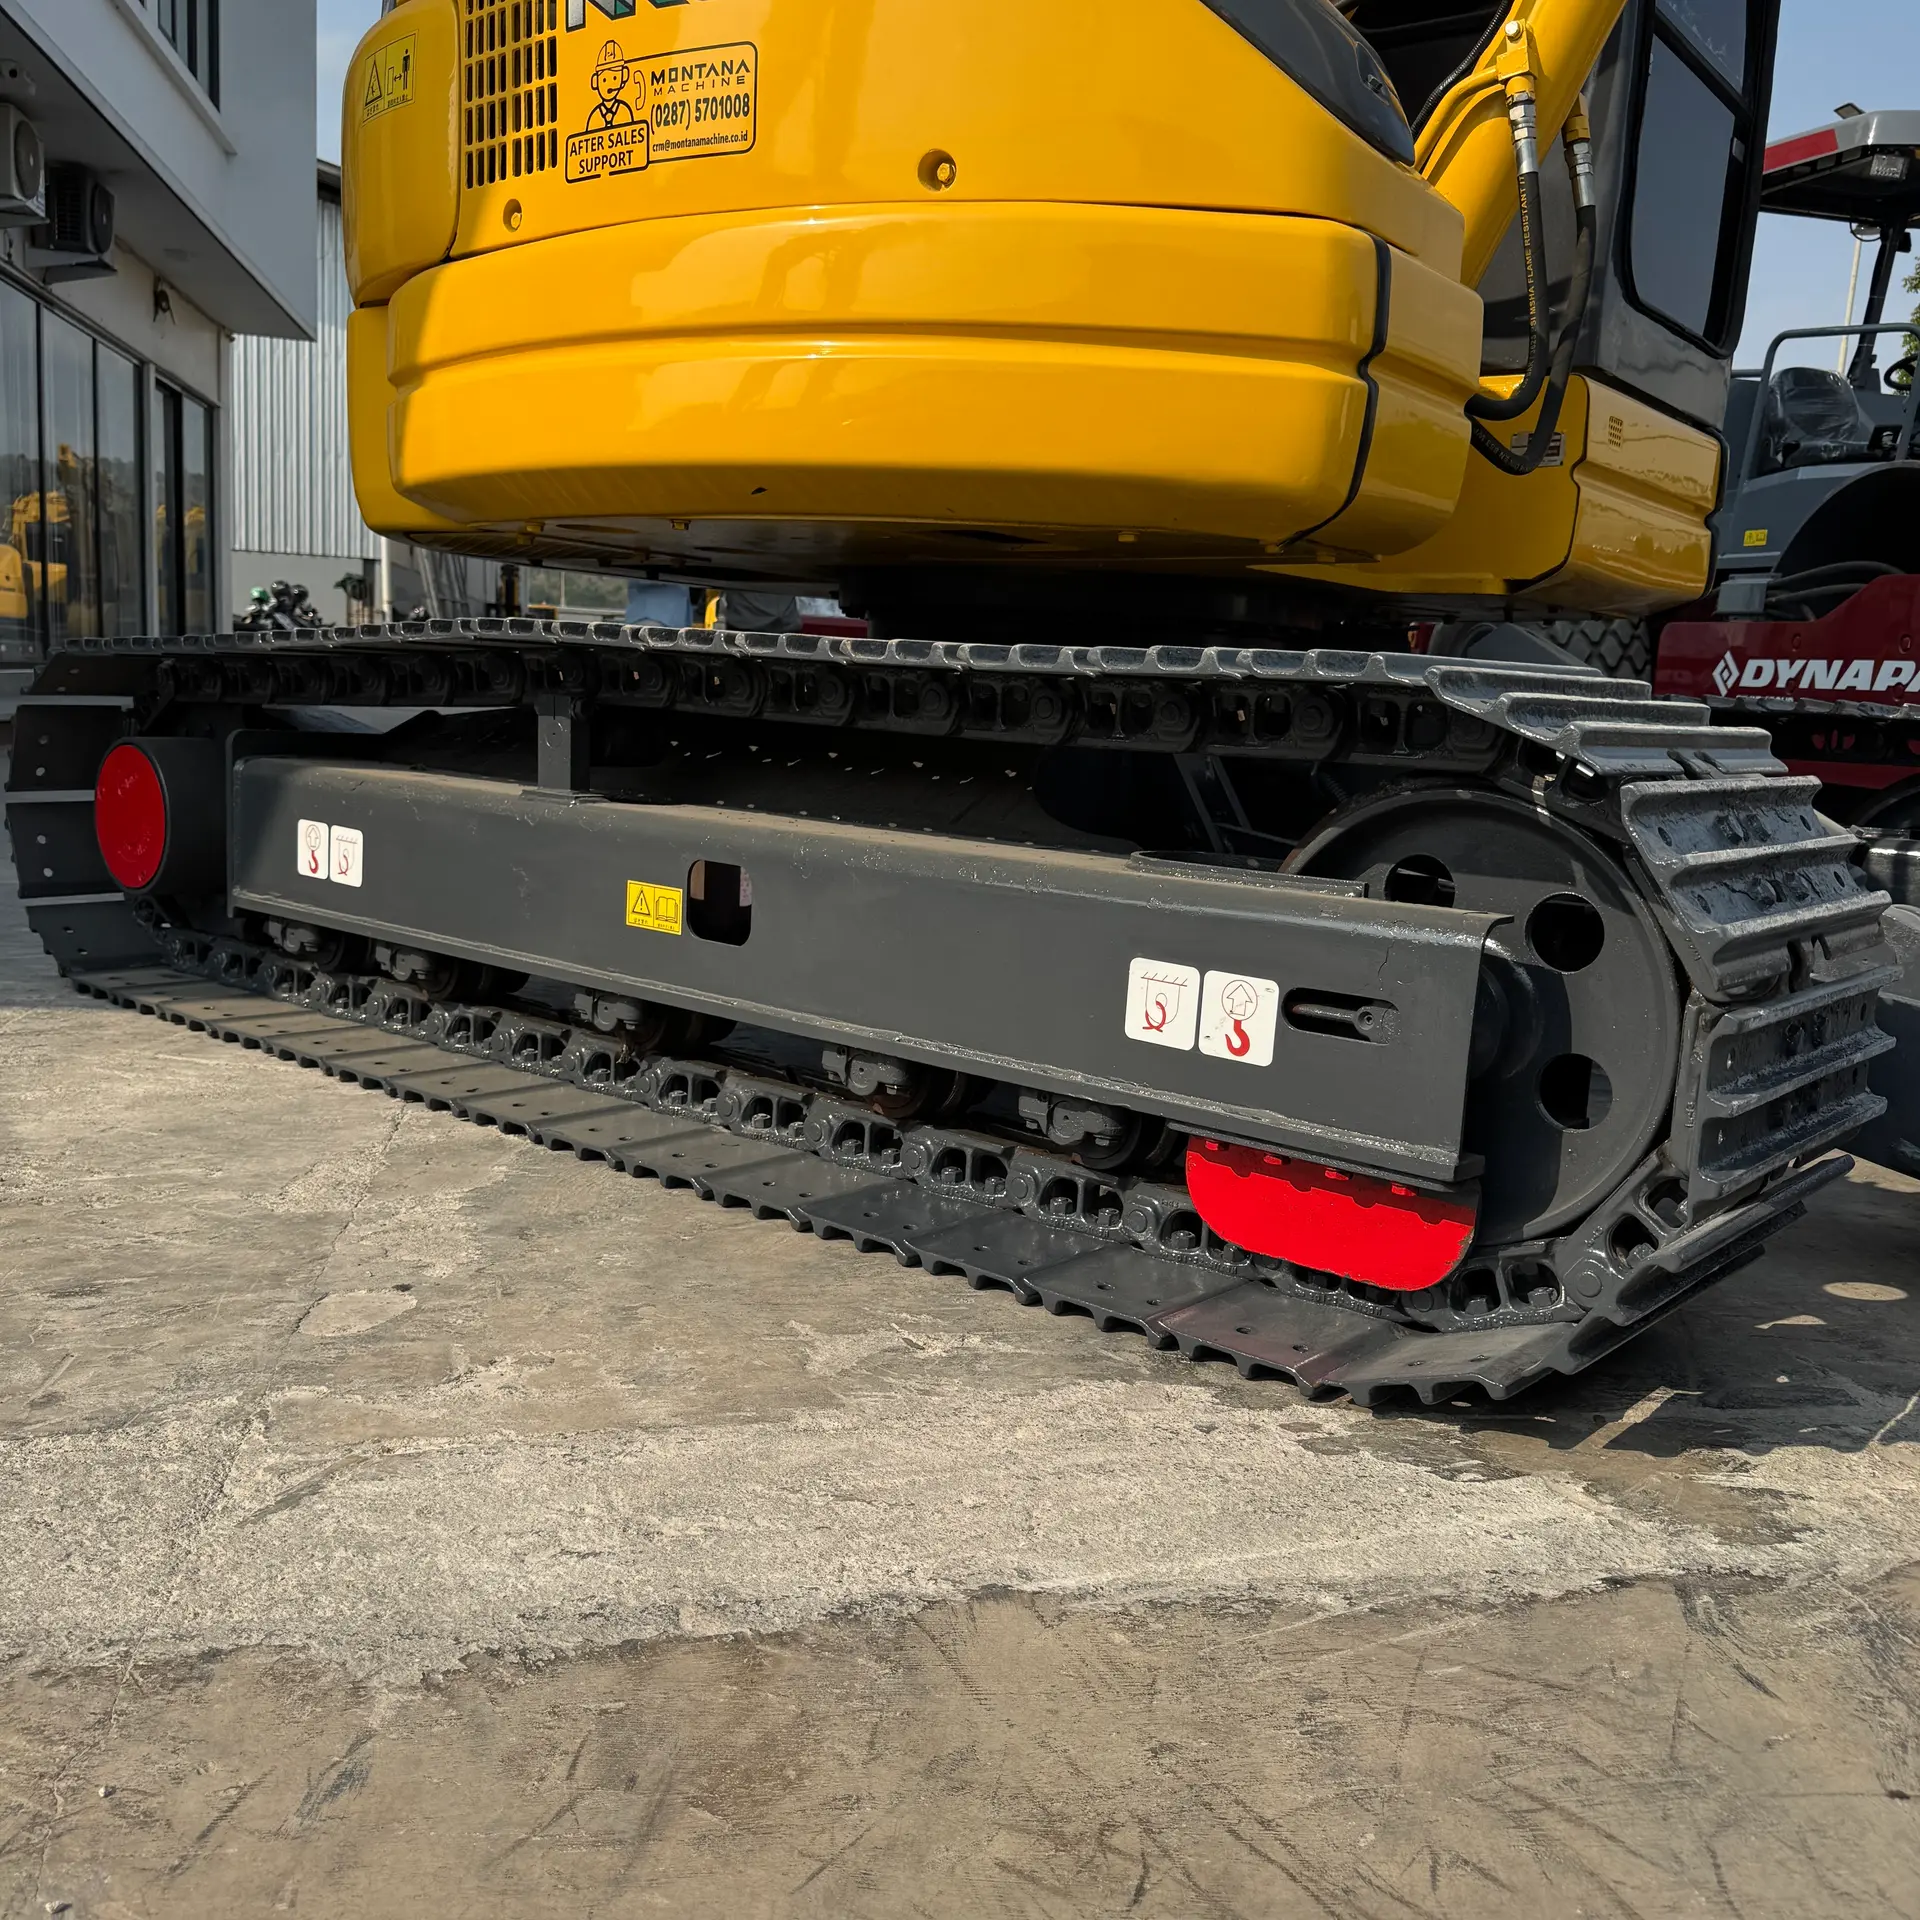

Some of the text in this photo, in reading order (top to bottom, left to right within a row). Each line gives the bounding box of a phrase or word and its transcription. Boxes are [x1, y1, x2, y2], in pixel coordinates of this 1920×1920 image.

[650, 59, 751, 86] MONTANA
[653, 75, 746, 96] MACHINE
[650, 93, 750, 135] (0287) 5701008
[569, 128, 645, 157] AFTER SALES
[652, 130, 749, 153] crm@montanamachine.co.id
[578, 150, 634, 175] SUPPORT
[1520, 188, 1531, 246] RESISTANT
[1525, 249, 1533, 284] FLAME
